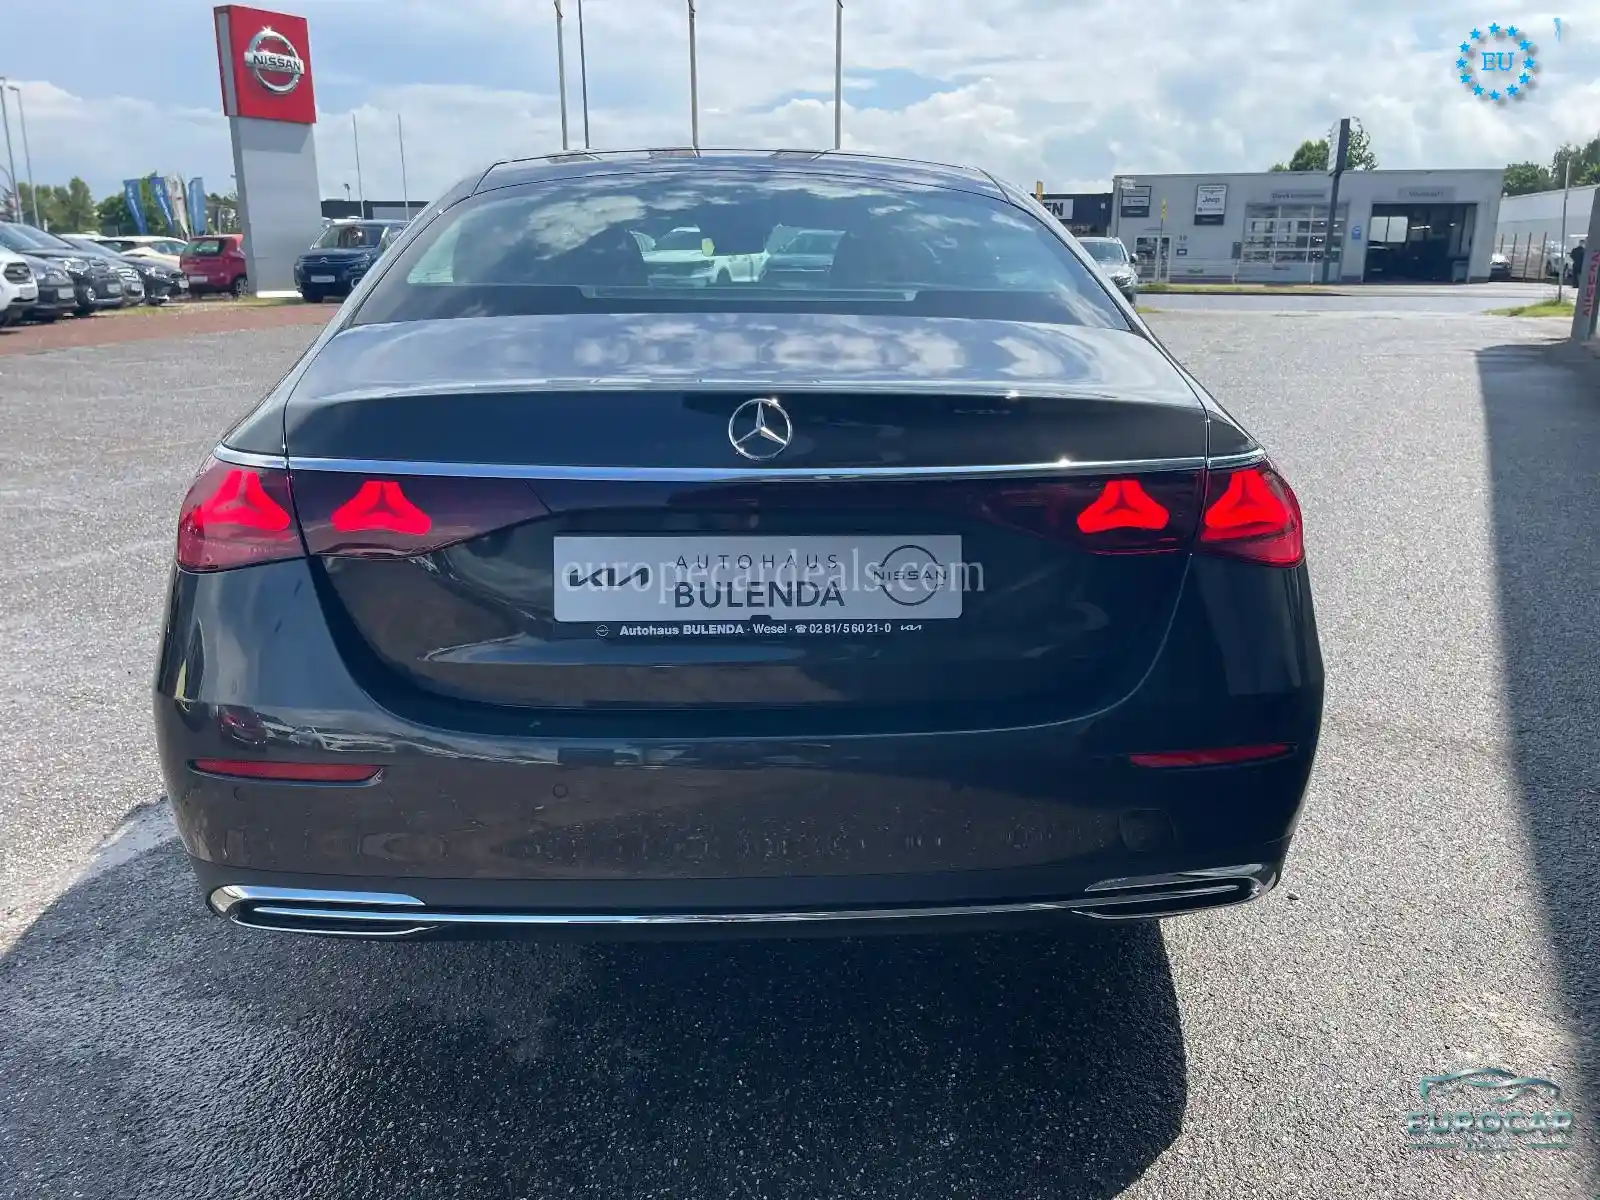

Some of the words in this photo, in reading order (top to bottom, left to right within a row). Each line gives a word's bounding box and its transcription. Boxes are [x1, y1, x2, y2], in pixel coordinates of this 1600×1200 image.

[252, 54, 301, 72] NISSAN
[675, 554, 838, 570] AUTOHAUS
[569, 567, 650, 587] KIA
[873, 570, 947, 581] NISSAN
[674, 580, 846, 609] BULENDA
[619, 624, 680, 636] Autohaus
[682, 623, 745, 635] BULENDA
[753, 623, 788, 634] Wesel
